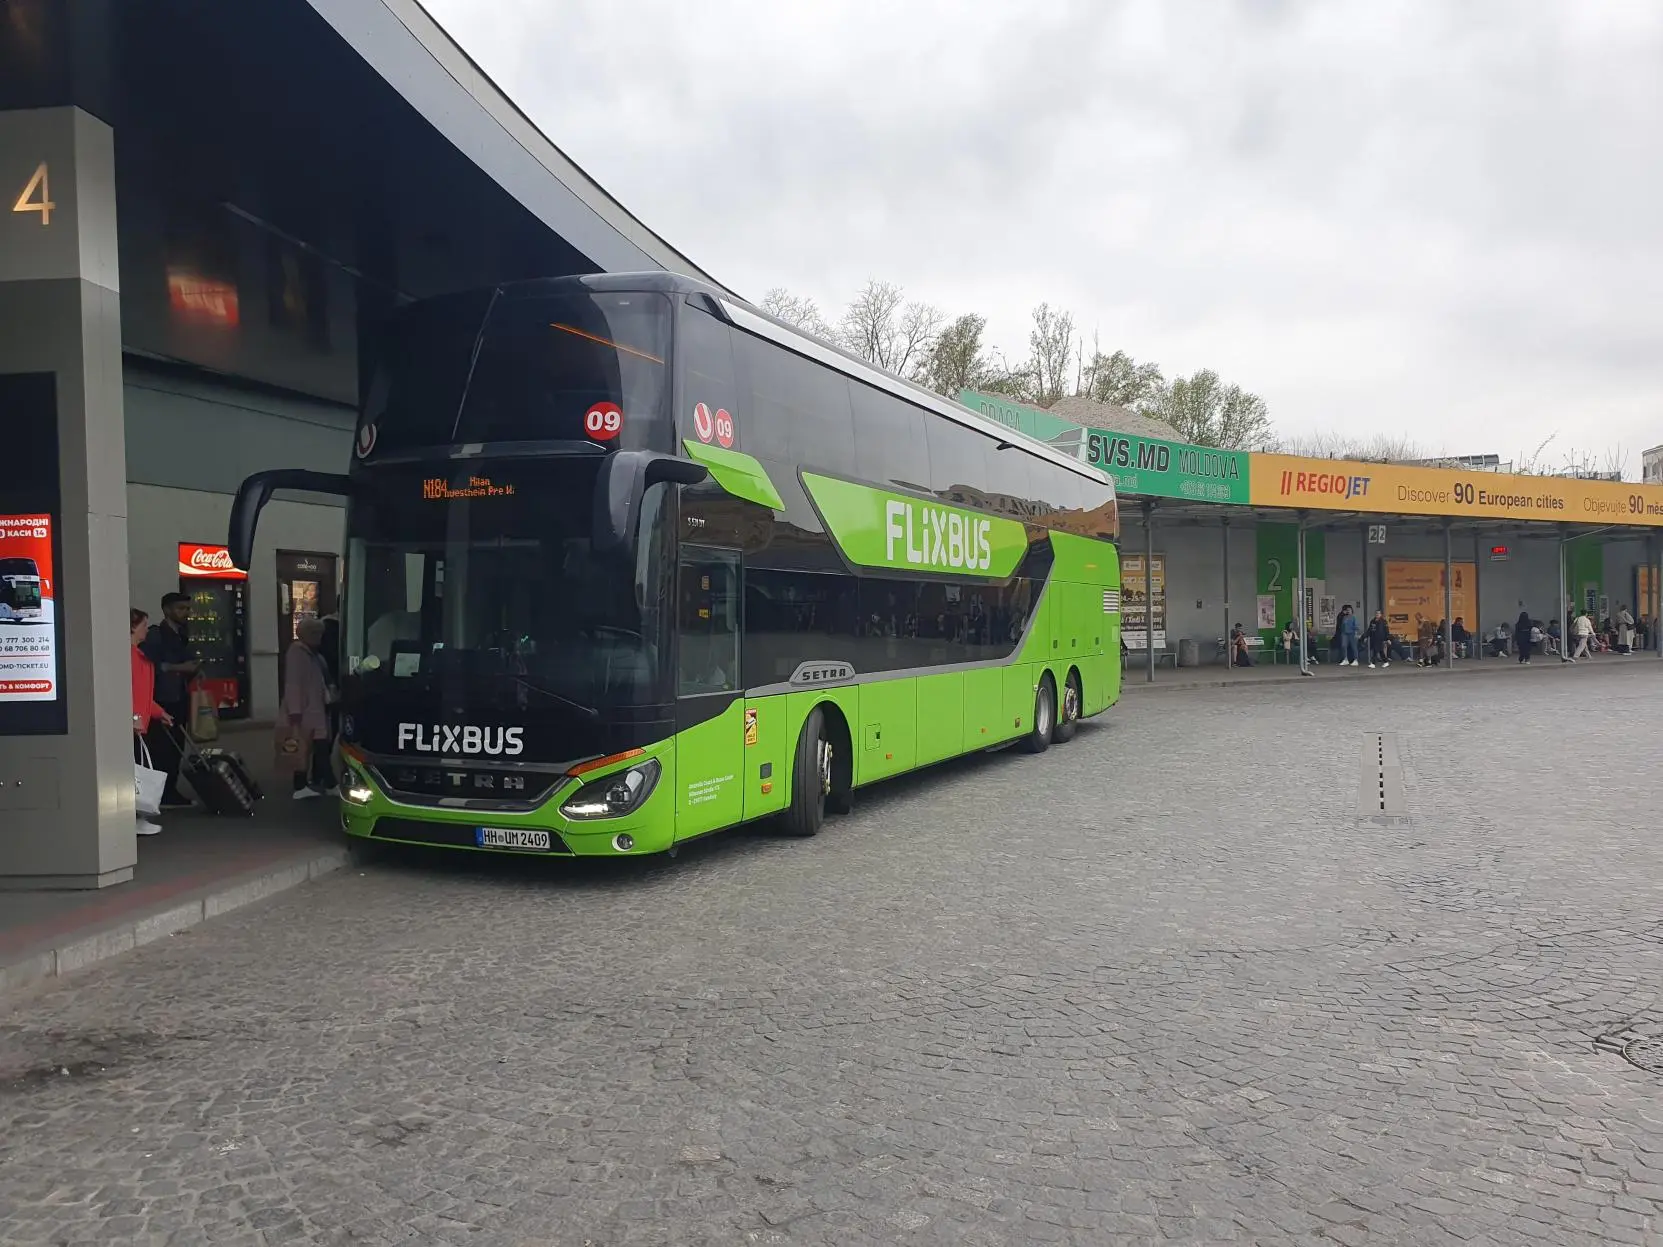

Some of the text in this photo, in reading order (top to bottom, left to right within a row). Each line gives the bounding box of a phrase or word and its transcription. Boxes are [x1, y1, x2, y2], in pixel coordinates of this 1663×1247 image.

[12, 160, 56, 225] 4
[586, 410, 621, 432] 09
[716, 418, 732, 438] 09
[1087, 433, 1240, 480] SVS.MD MOLDOVA
[423, 478, 448, 499] N184
[1296, 472, 1371, 499] REGIOJET
[1397, 482, 1564, 509] Discover 90 European cities
[1583, 497, 1627, 515] Objevujte
[1628, 494, 1644, 514] 90
[7, 529, 32, 537] КАСИ
[1267, 558, 1282, 591] 2
[802, 668, 846, 681] SETRA
[483, 830, 548, 847] HH UM 2409
